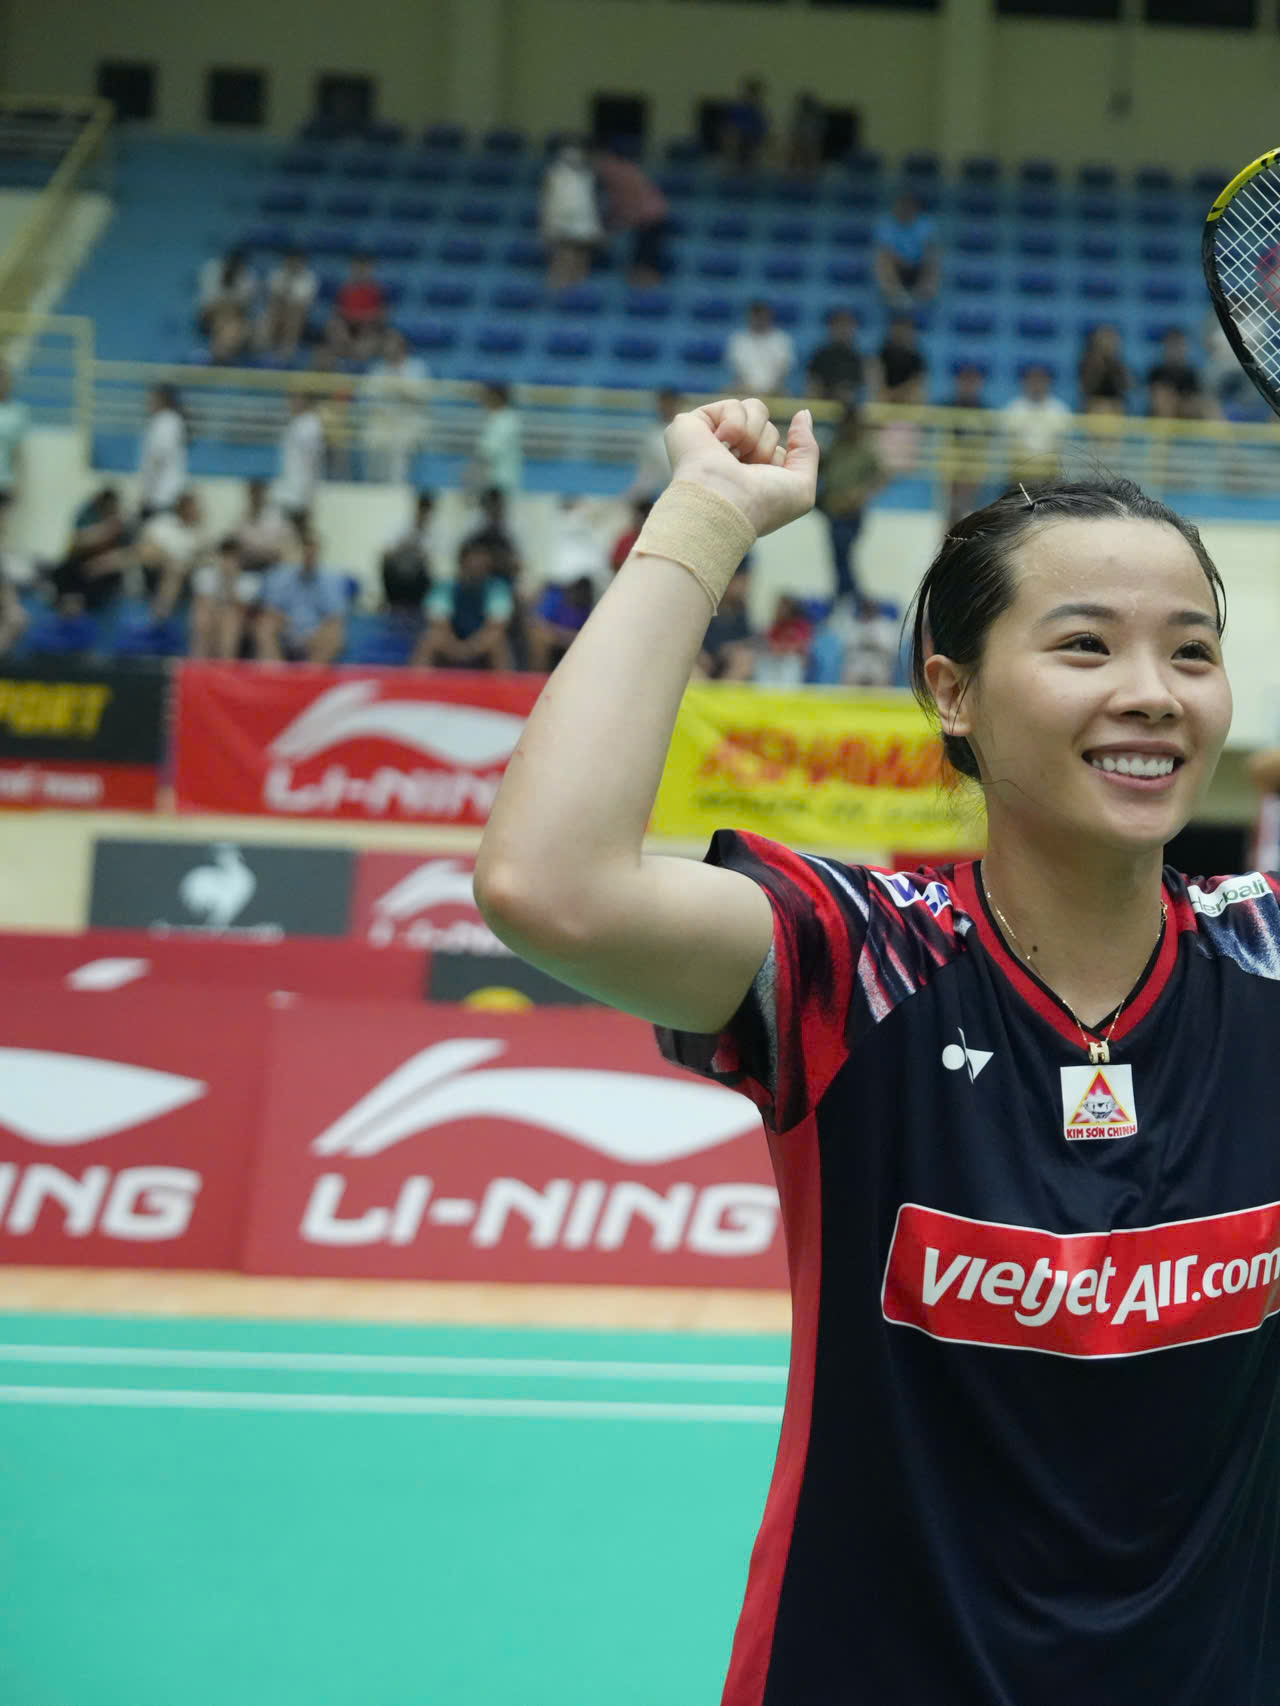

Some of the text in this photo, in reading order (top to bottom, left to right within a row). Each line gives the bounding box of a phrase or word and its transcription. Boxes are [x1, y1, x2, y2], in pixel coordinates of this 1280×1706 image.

[1066, 1128, 1084, 1139] KIM
[1107, 1124, 1137, 1137] CHINH
[299, 1172, 781, 1257] LI-NING
